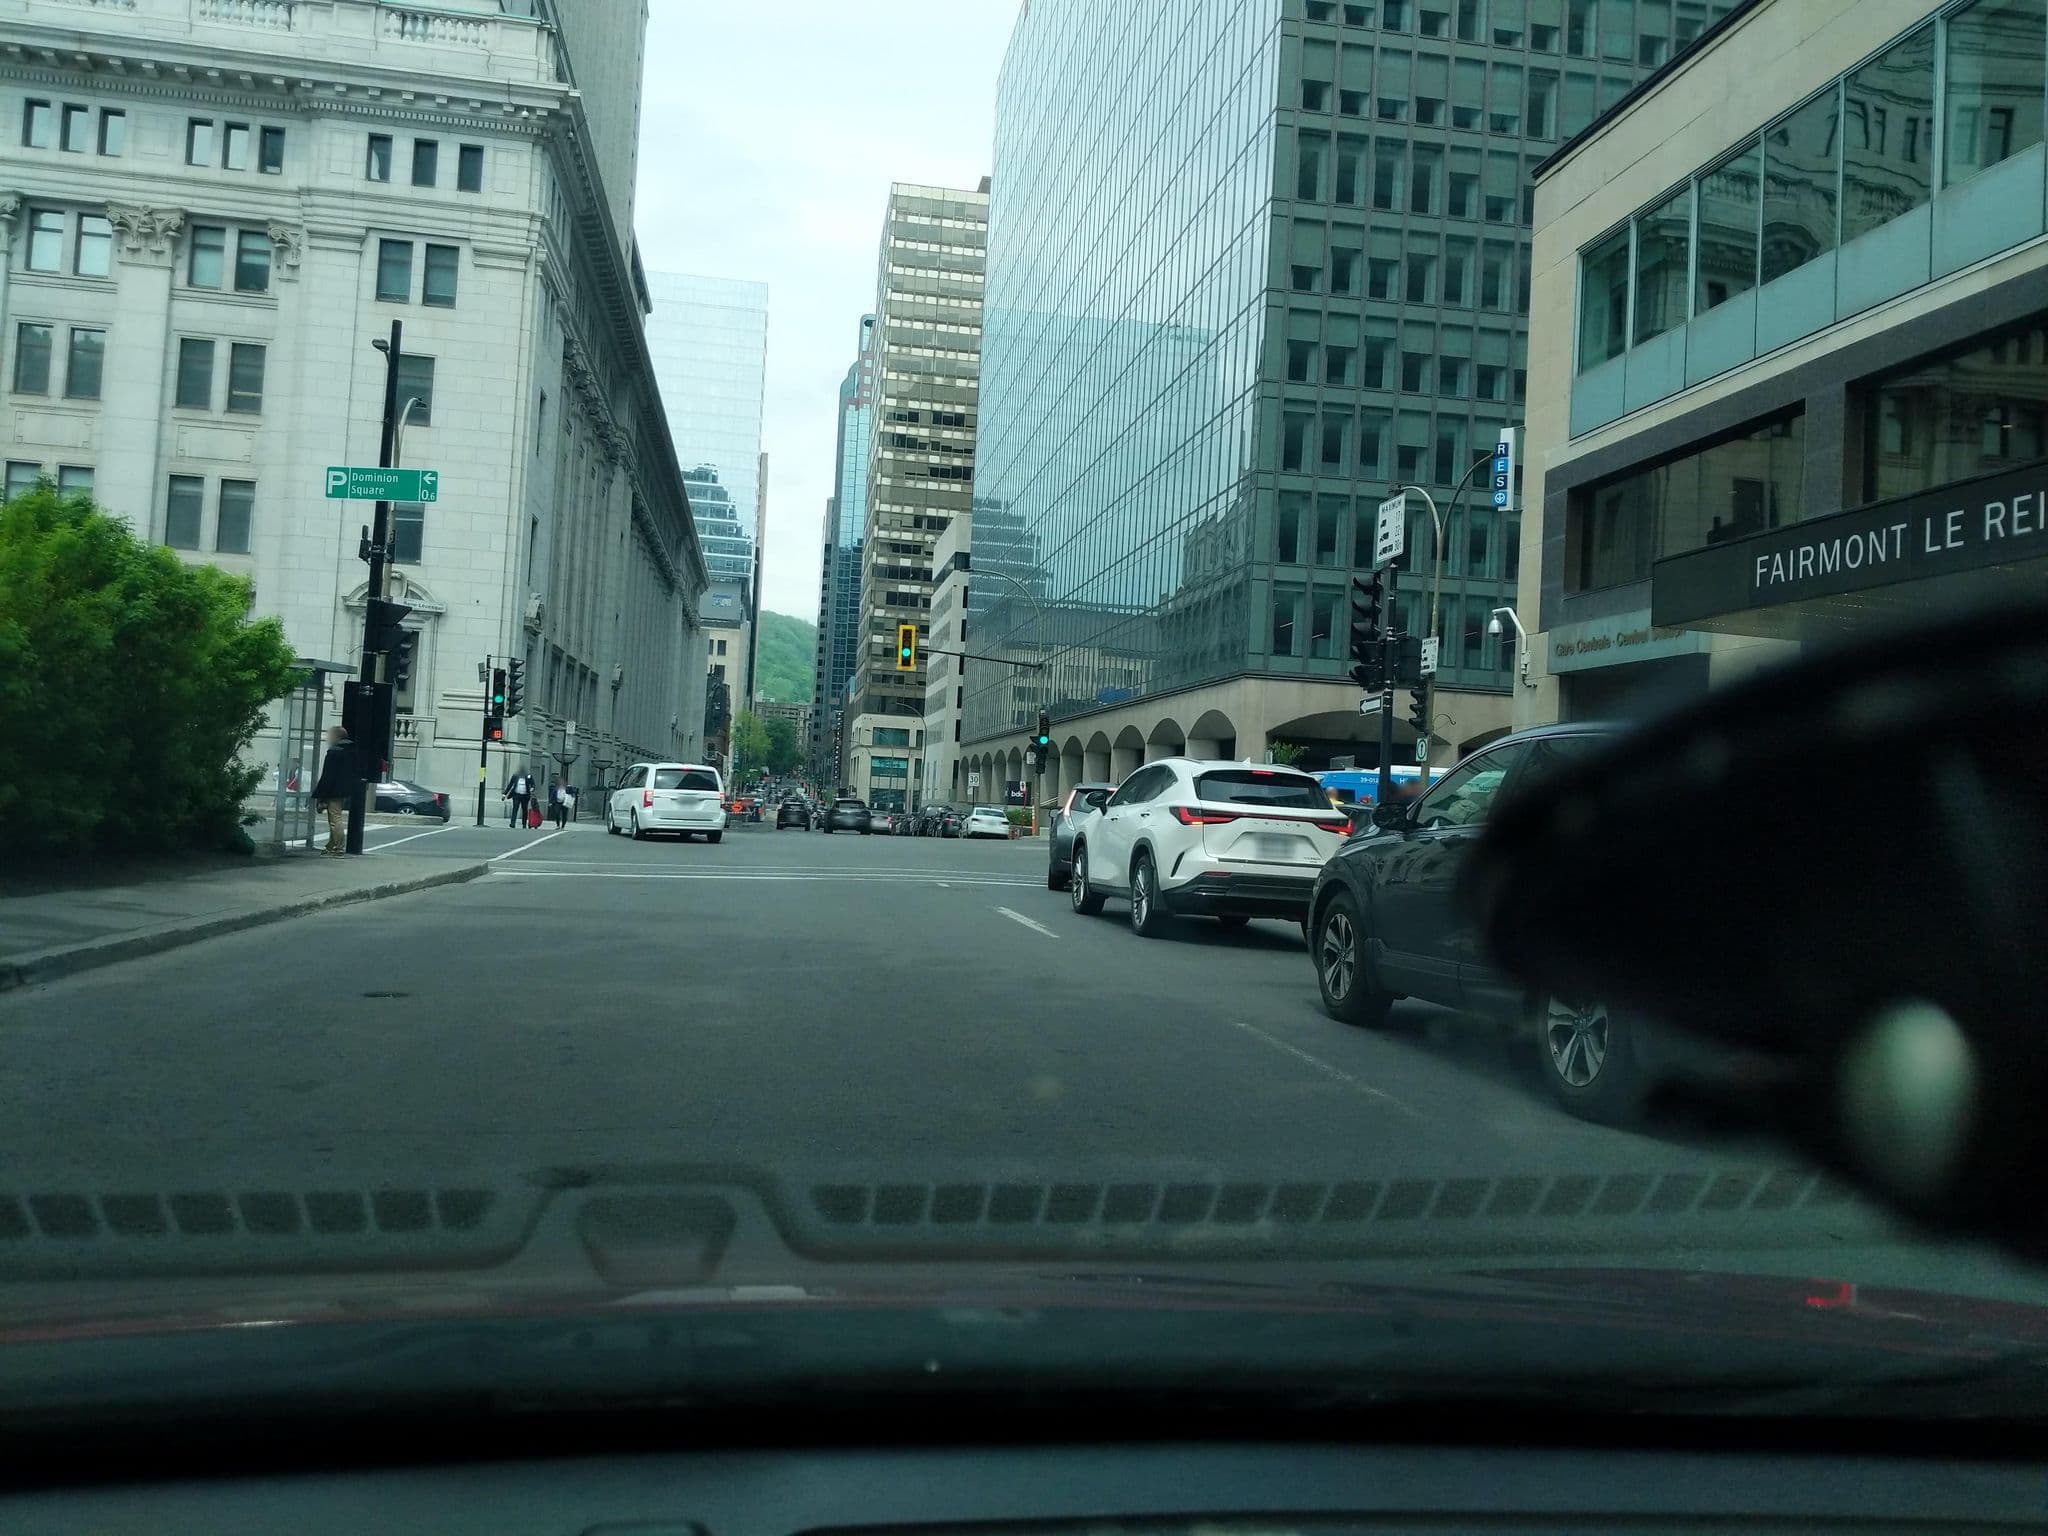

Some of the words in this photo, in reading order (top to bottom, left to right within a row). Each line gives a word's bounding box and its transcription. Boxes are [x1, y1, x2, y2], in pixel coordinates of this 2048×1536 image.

[327, 470, 348, 494] P
[352, 472, 399, 483] Dominion
[351, 485, 385, 496] Square
[1756, 523, 1908, 588] FAIRMONT
[1925, 509, 1965, 553] LE
